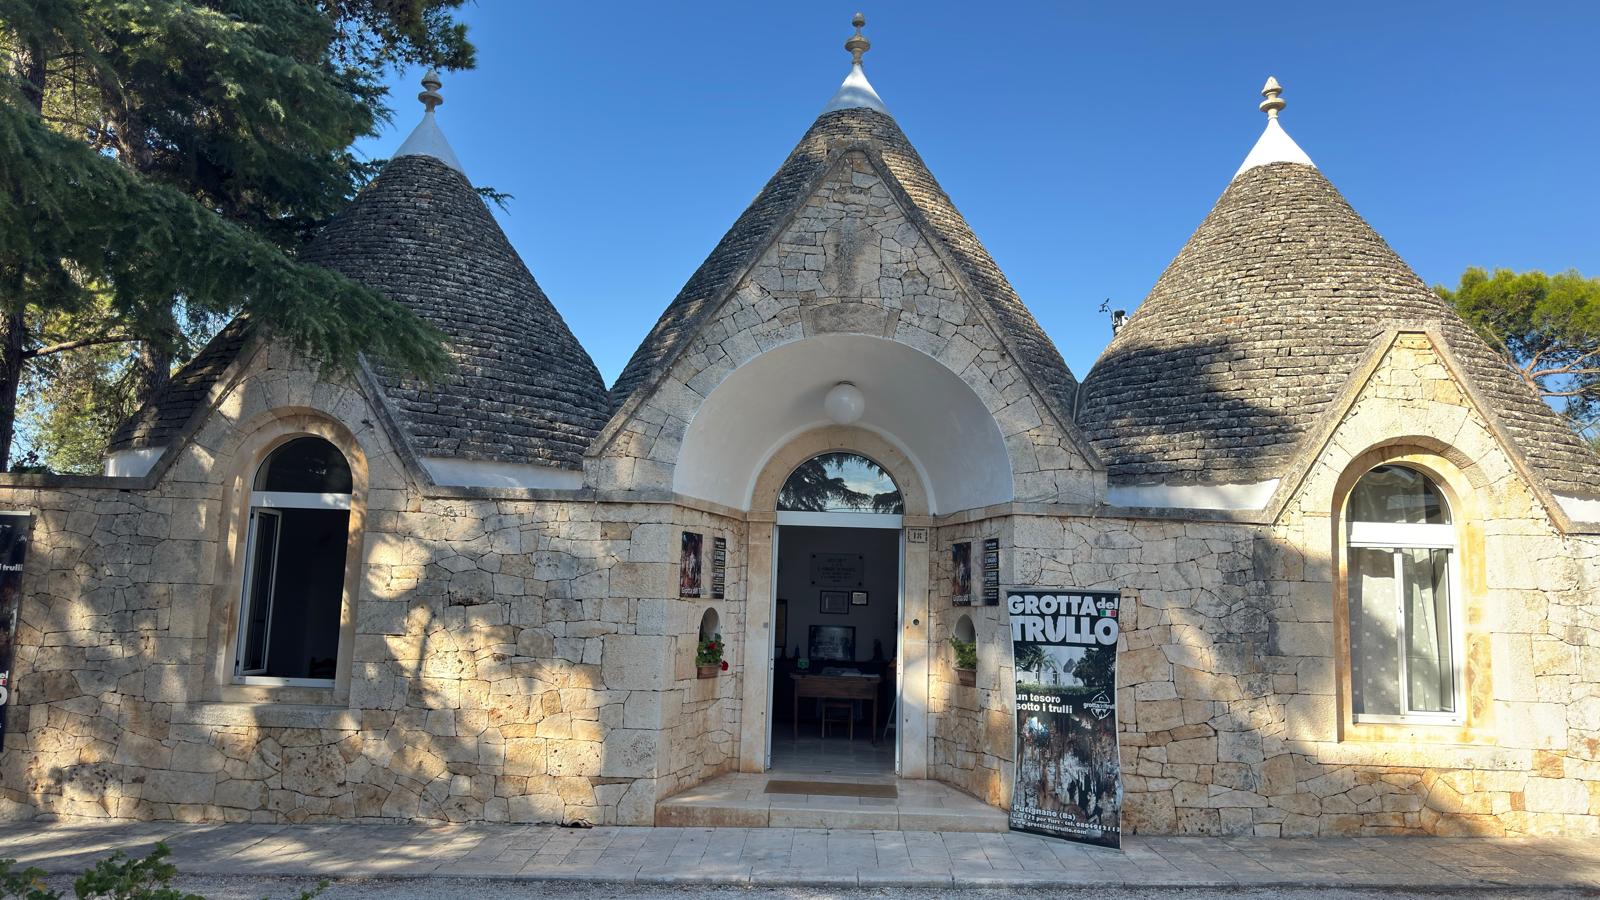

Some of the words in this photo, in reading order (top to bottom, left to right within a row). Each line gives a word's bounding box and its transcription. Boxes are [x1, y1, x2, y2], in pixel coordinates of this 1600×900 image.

[2, 563, 24, 571] trulli
[1008, 595, 1099, 616] GROTTA
[1097, 597, 1119, 610] del
[1010, 615, 1119, 646] TRULLO
[1029, 693, 1061, 703] tesoro
[1016, 702, 1040, 711] sotto
[1042, 702, 1046, 712] i
[1048, 704, 1073, 714] trulli
[1013, 804, 1057, 817] Putignano
